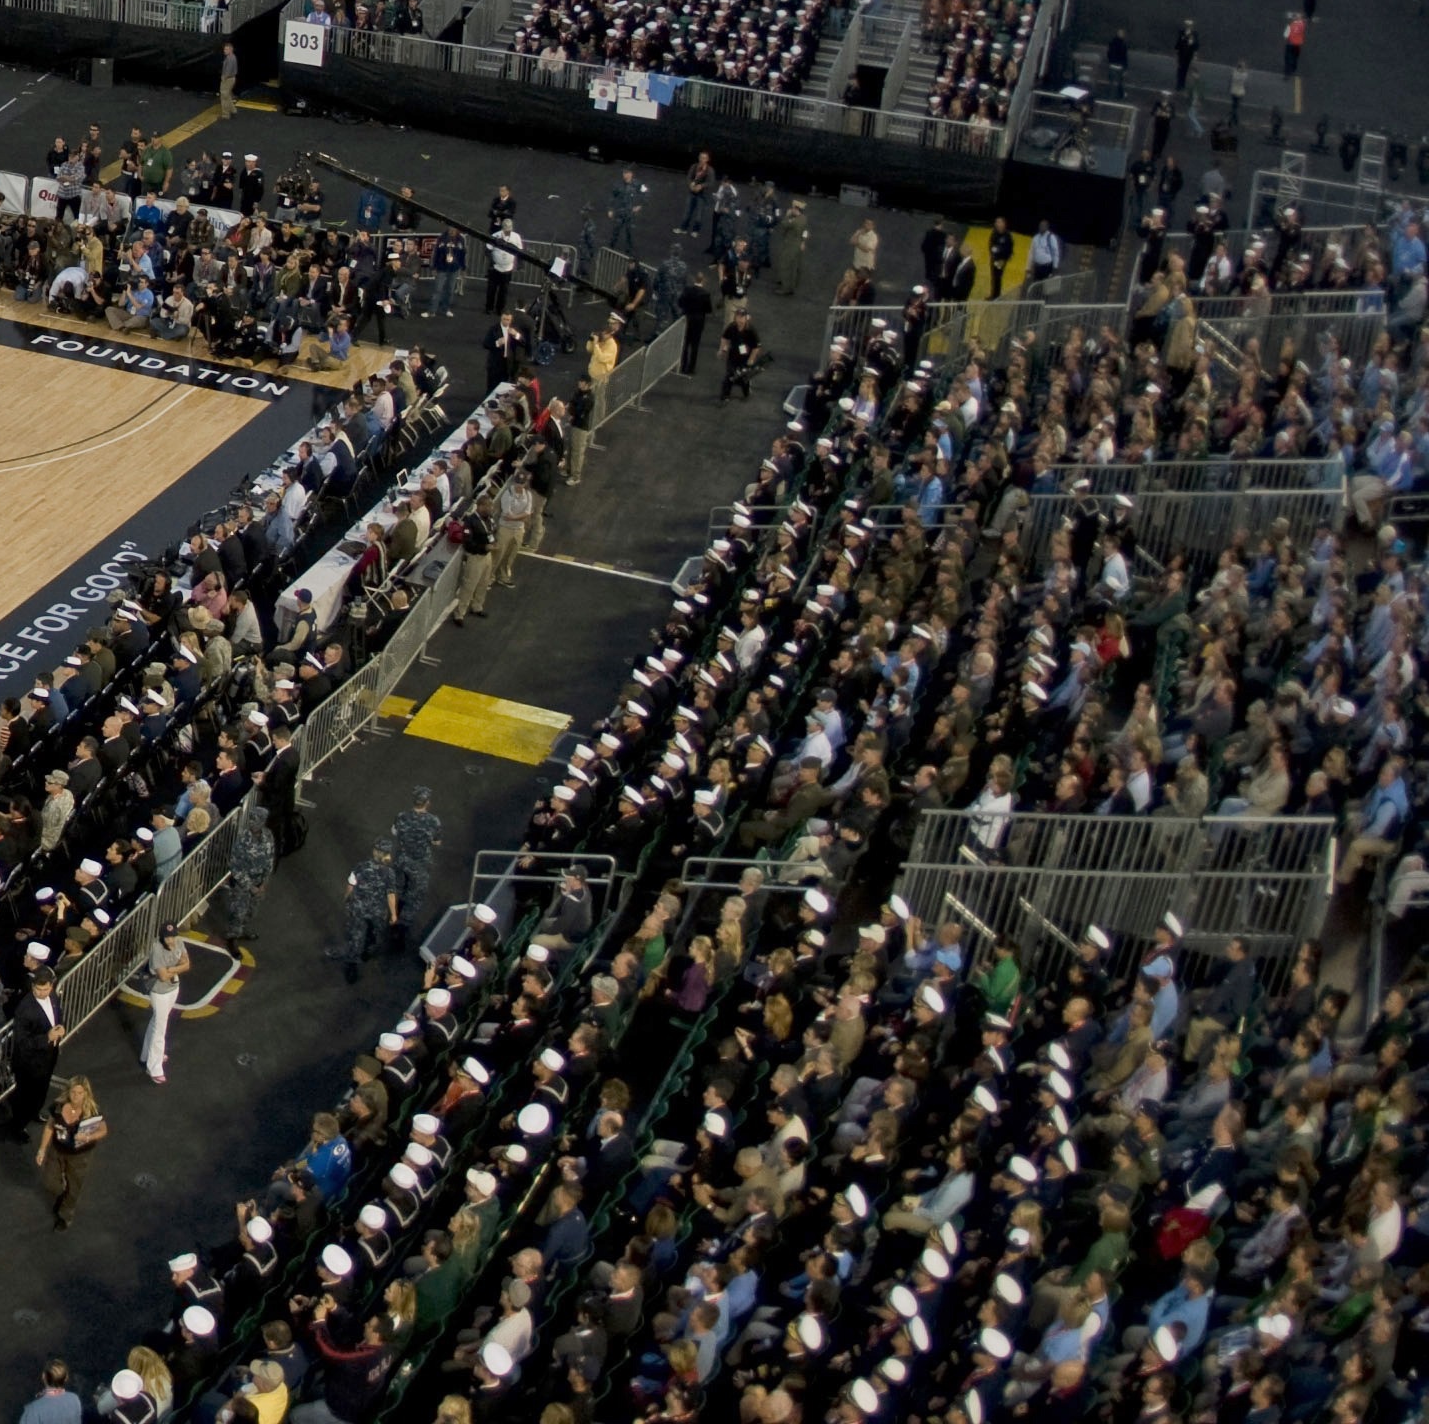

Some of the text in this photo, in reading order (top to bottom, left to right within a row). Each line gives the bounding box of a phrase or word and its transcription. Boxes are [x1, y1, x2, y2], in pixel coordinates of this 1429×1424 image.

[289, 32, 319, 51] 303
[31, 334, 289, 396] FOUNDATION
[17, 603, 89, 644] FOR
